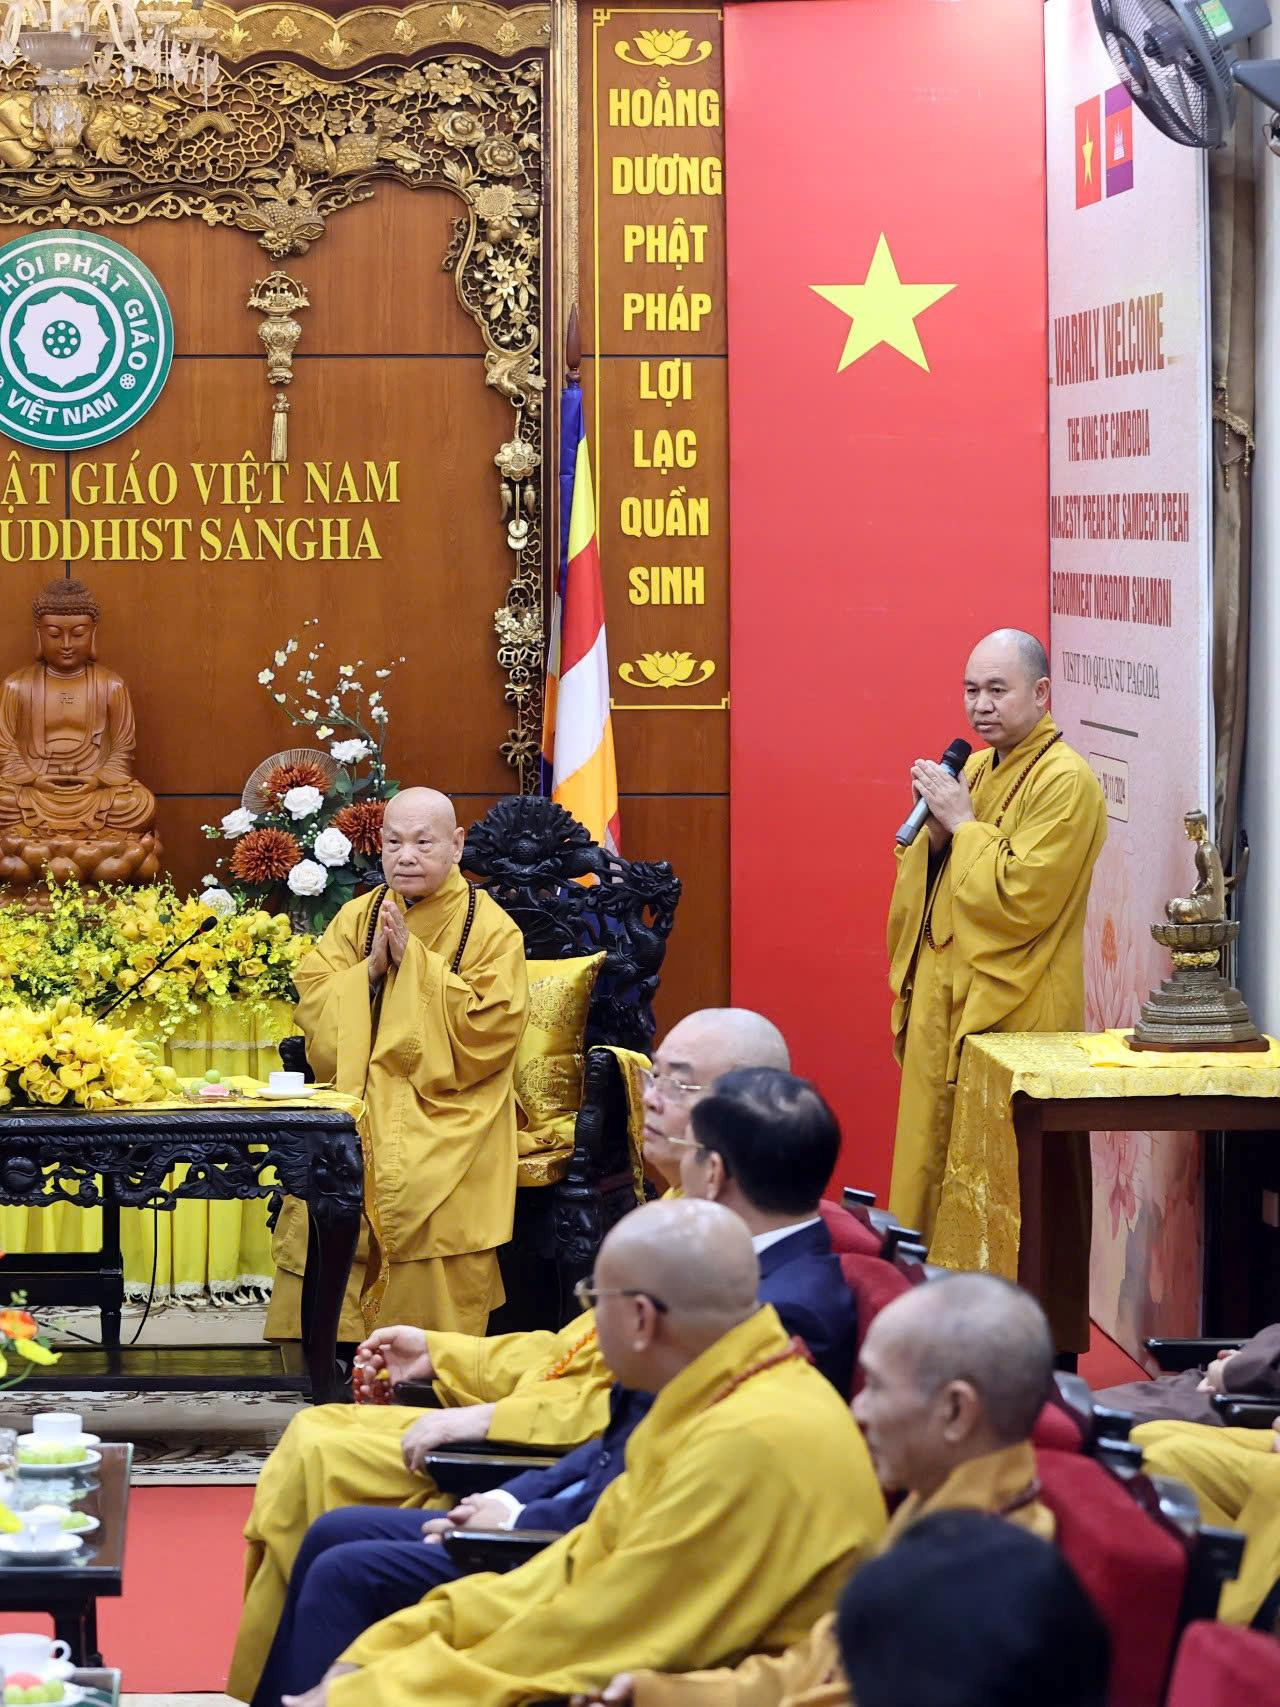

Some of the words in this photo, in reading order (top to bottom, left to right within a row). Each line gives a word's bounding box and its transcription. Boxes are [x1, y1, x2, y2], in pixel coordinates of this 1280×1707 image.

[609, 76, 720, 127] HOẰNG
[612, 153, 722, 195] DƯƠNG
[624, 217, 708, 270] PHẬT
[54, 252, 129, 293] PHẬT
[124, 298, 155, 371] GIÁO
[623, 285, 712, 331] PHÁP
[1054, 308, 1099, 386] WARMLY
[1103, 292, 1164, 378] WELCOME
[7, 388, 59, 426] VIỆT
[63, 391, 119, 426] NAM
[639, 358, 692, 407] LỢI
[634, 429, 697, 475] LẠC
[1067, 417, 1080, 462] THE
[1081, 415, 1098, 460] KING
[1099, 413, 1109, 460] OF
[1110, 409, 1151, 459] CAMBODIA
[71, 449, 178, 505] GIÁO
[190, 450, 290, 513] VIỆT
[304, 461, 401, 504] NAM
[620, 486, 709, 538] QUẦN
[1051, 495, 1080, 539] MAJESTY
[1083, 495, 1105, 540] PREAH
[1108, 494, 1120, 540] BAT
[1122, 493, 1159, 541] SAMDECH
[1161, 493, 1189, 542] PREAH
[200, 517, 382, 561] SANGHA
[628, 566, 705, 606] SINH
[1052, 571, 1092, 618] BOROMNEAT
[1094, 574, 1130, 622] NORODOM
[1132, 576, 1171, 628] SIHAMONI
[1062, 652, 1081, 684] VISIT
[1082, 654, 1092, 686] TO
[1093, 655, 1114, 694] QUAN
[1115, 659, 1127, 693] SU
[1127, 662, 1160, 699] PAGODA
